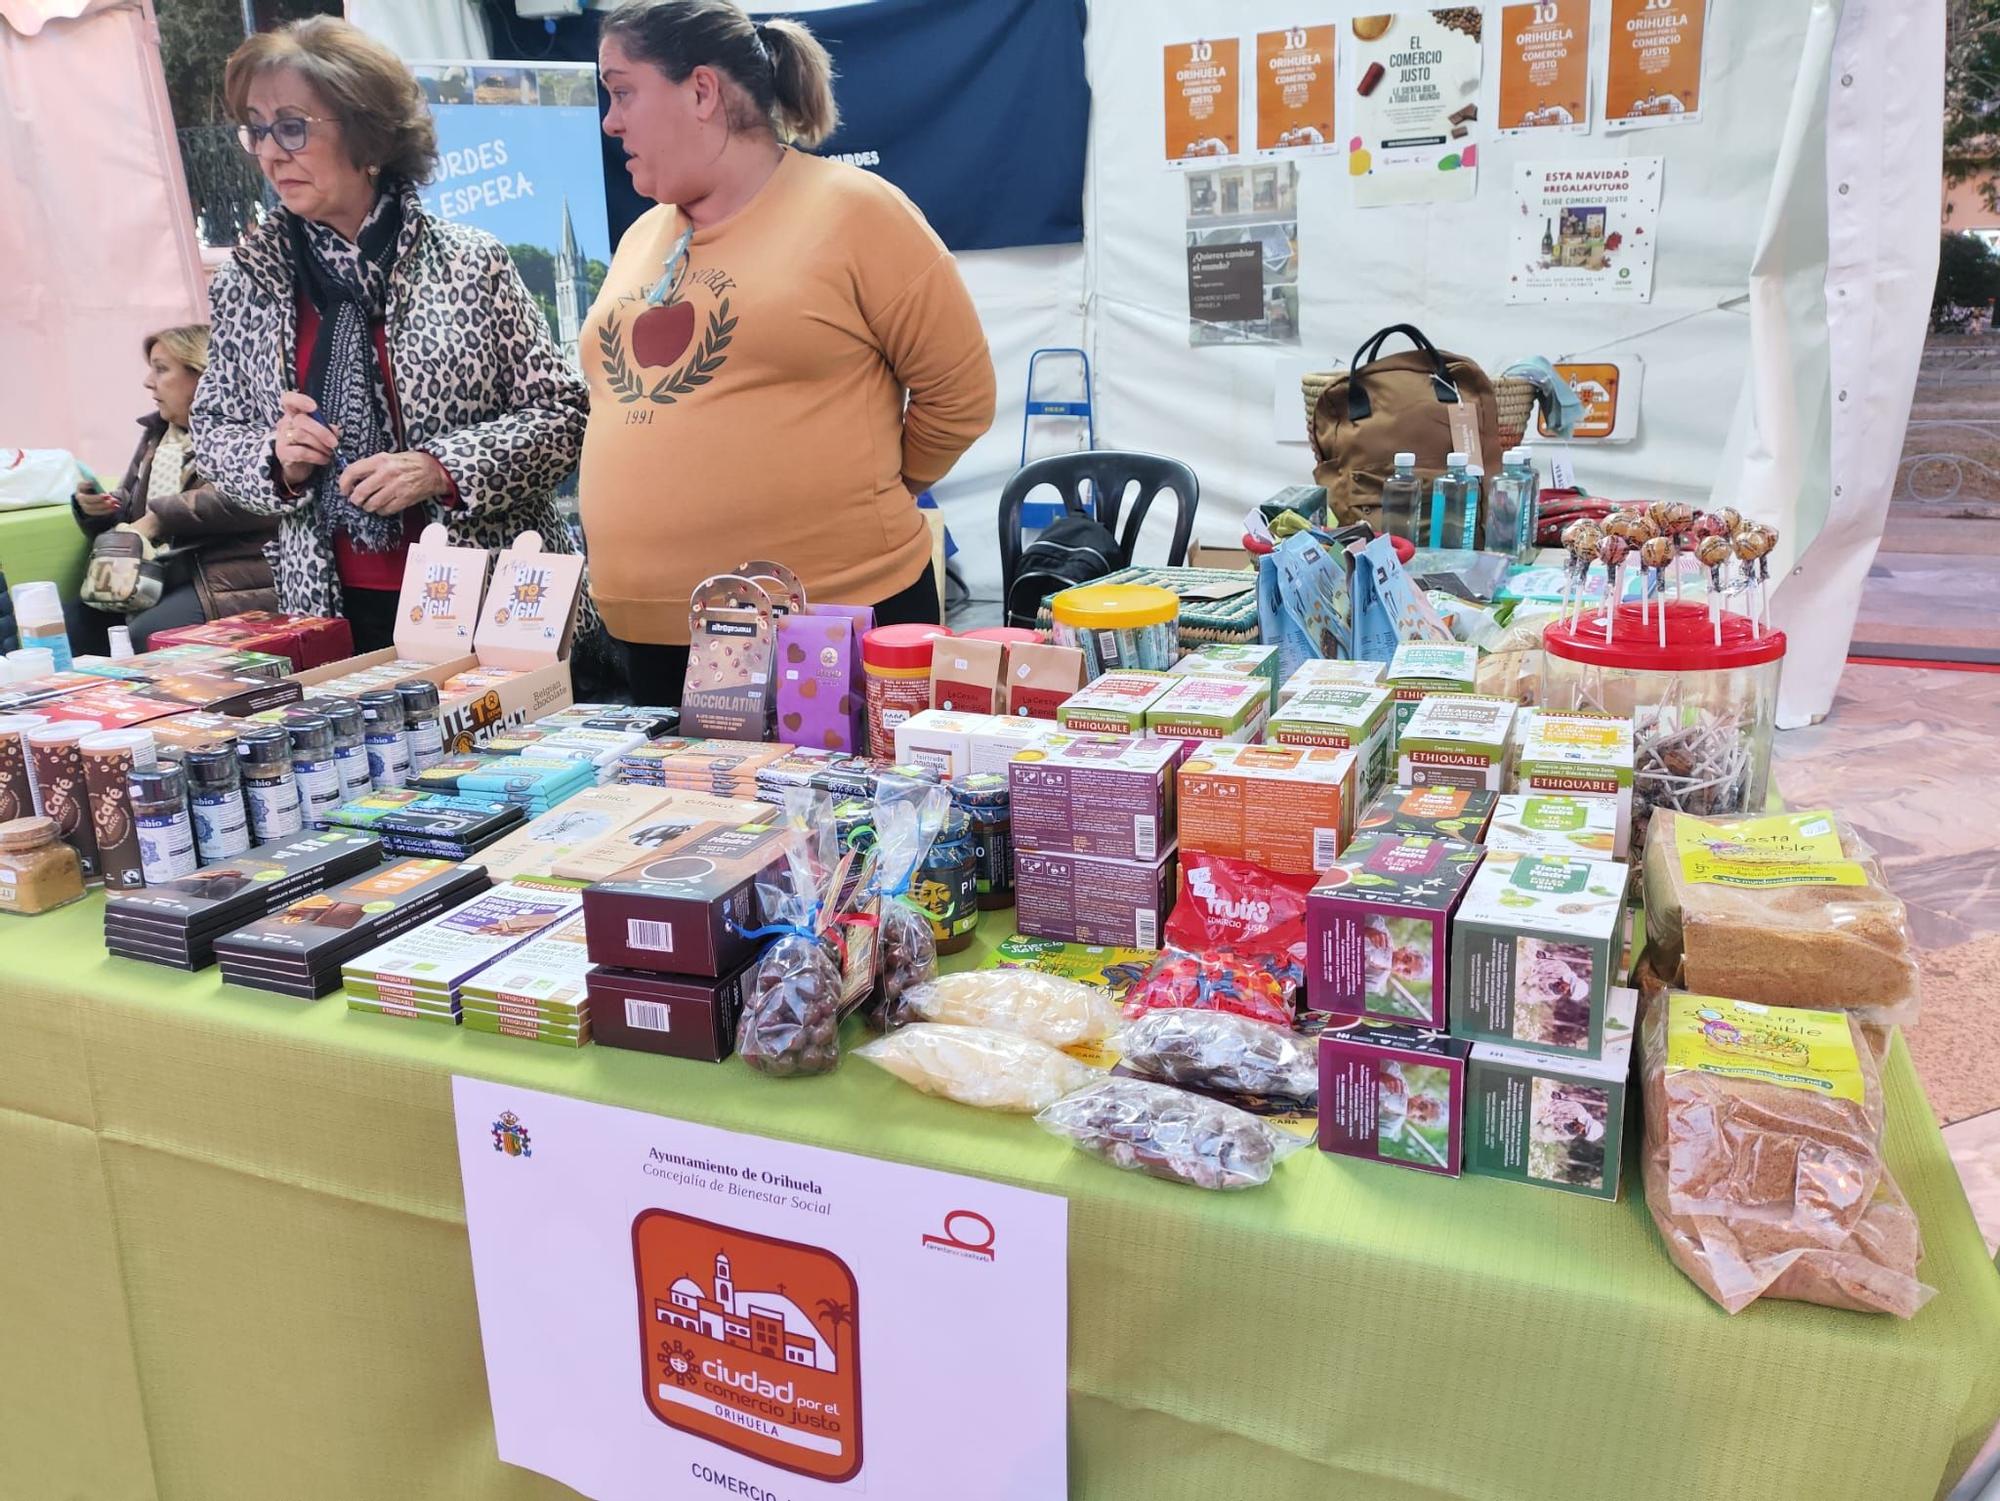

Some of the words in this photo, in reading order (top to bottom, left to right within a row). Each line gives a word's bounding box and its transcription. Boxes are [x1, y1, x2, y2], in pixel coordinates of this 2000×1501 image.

[1533, 3, 1558, 24] 10
[1626, 14, 1688, 32] ORIHUELA
[1284, 30, 1307, 50] 10
[1410, 36, 1422, 50] EL
[1516, 29, 1573, 45] ORIHUELA
[1632, 35, 1681, 48] COMERCIO
[1190, 43, 1212, 62] 10
[1389, 50, 1442, 68] COMERCIO
[1522, 49, 1567, 62] COMERCIO
[1641, 47, 1669, 58] JUSTO
[1269, 54, 1321, 70] ORIHUELA
[1531, 60, 1557, 70] JUSTO
[1176, 66, 1226, 81] ORIHUELA
[1400, 67, 1431, 83] JUSTO
[1545, 172, 1572, 182] ESTA
[1576, 170, 1629, 180] NAVIDAD
[440, 172, 534, 218] ESPERA
[1544, 183, 1629, 193] #REGALAFUTURO
[1225, 248, 1256, 259] cambiar
[688, 268, 737, 299] YORK
[625, 410, 654, 425] 1991
[427, 564, 459, 583] BITE
[516, 567, 551, 585] BITE
[533, 687, 568, 711] chocolate
[684, 693, 761, 713] NOCCIOLATINI
[439, 705, 474, 740] ITE
[1067, 720, 1129, 734] ETHIQUABLE
[1157, 725, 1221, 737] ETHIQUABLE
[1280, 733, 1347, 748] ETHIQUABLE
[1412, 752, 1487, 766] ETHIQUABLE
[1533, 778, 1616, 791] ETHIQUABLE
[45, 776, 74, 815] Café
[95, 786, 124, 826] Café
[1207, 916, 1241, 928] COMERCIO
[1001, 940, 1064, 950] Comercio
[376, 973, 412, 985] ETHIQUABLE
[378, 985, 414, 997] ETHIQUABLE
[497, 992, 536, 1005] ETHIQUABLE
[382, 1006, 418, 1018] ETHIQUABLE
[500, 1005, 538, 1017] ETHIQUABLE
[500, 1016, 538, 1028] ETHIQUABLE
[500, 1026, 538, 1039] ETHIQUABLE
[649, 1147, 738, 1177] Ayuntamiento
[742, 1167, 758, 1181] de
[761, 1171, 823, 1195] Orihuela
[642, 1163, 706, 1188] Concejalía
[710, 1179, 724, 1192] de
[728, 1182, 788, 1205] Bienestar
[790, 1195, 832, 1216] Social
[702, 1358, 793, 1404] ciudad
[797, 1397, 821, 1411] por
[824, 1402, 840, 1416] el
[704, 1380, 784, 1417] comercio
[791, 1408, 841, 1433] justo
[714, 1405, 780, 1437] ORIHUELA
[691, 1463, 777, 1501] COMERCIO
